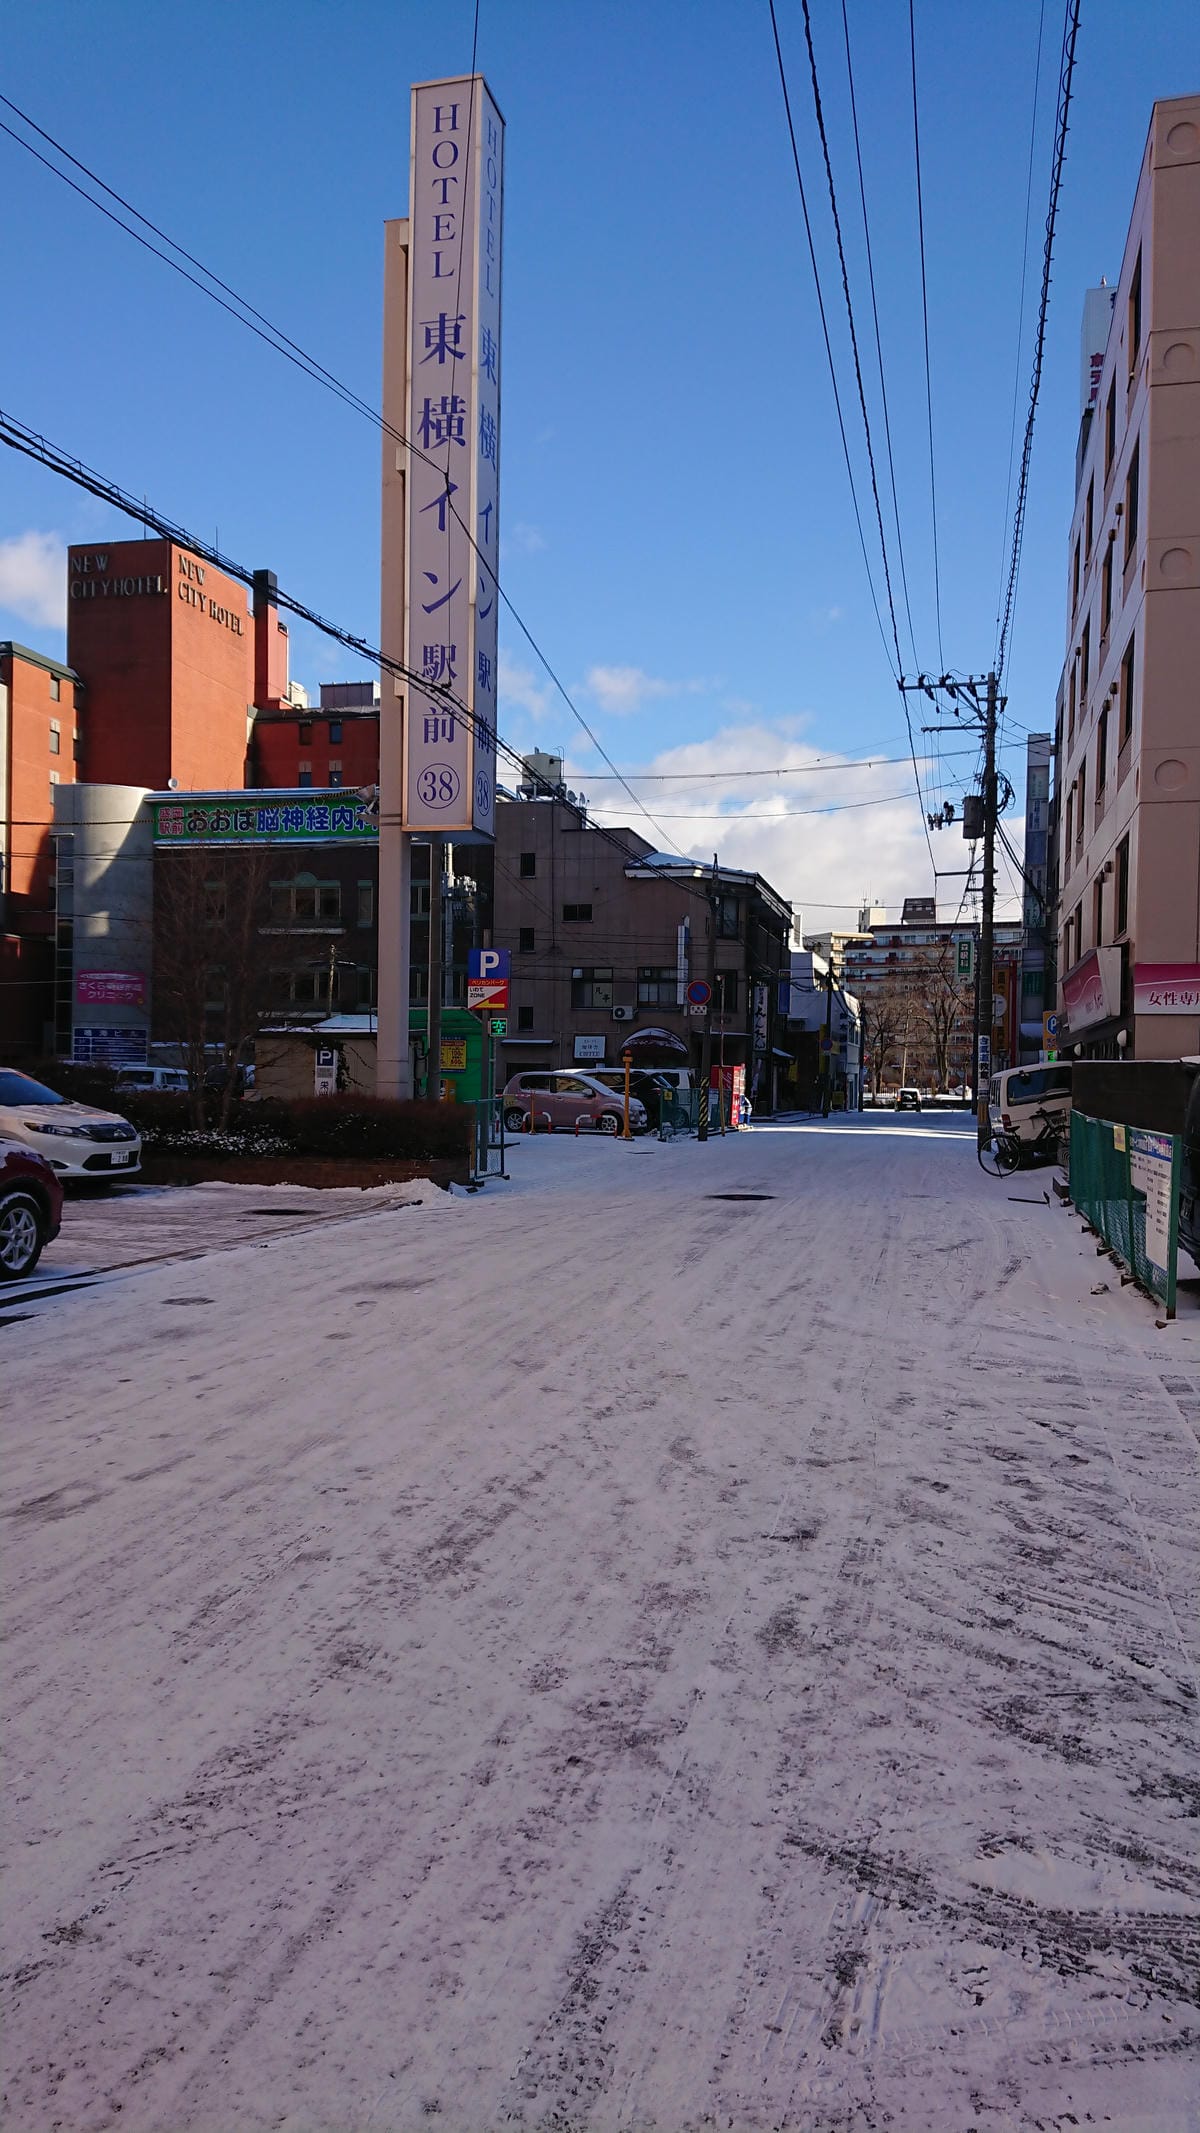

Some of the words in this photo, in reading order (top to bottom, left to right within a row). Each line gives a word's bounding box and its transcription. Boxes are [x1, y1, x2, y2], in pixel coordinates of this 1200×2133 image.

[432, 103, 461, 280] HOTEL
[483, 118, 498, 299] HOTEL
[71, 554, 109, 573] NEW
[178, 554, 206, 586] NEW
[71, 578, 111, 599] CITY
[114, 575, 168, 597] HOTEL
[178, 581, 207, 613] CITY
[209, 599, 244, 637] HOTEL
[159, 822, 185, 836] 駅前
[480, 951, 500, 979] P
[471, 979, 505, 987] ペリカンパーク
[319, 1050, 332, 1065] P
